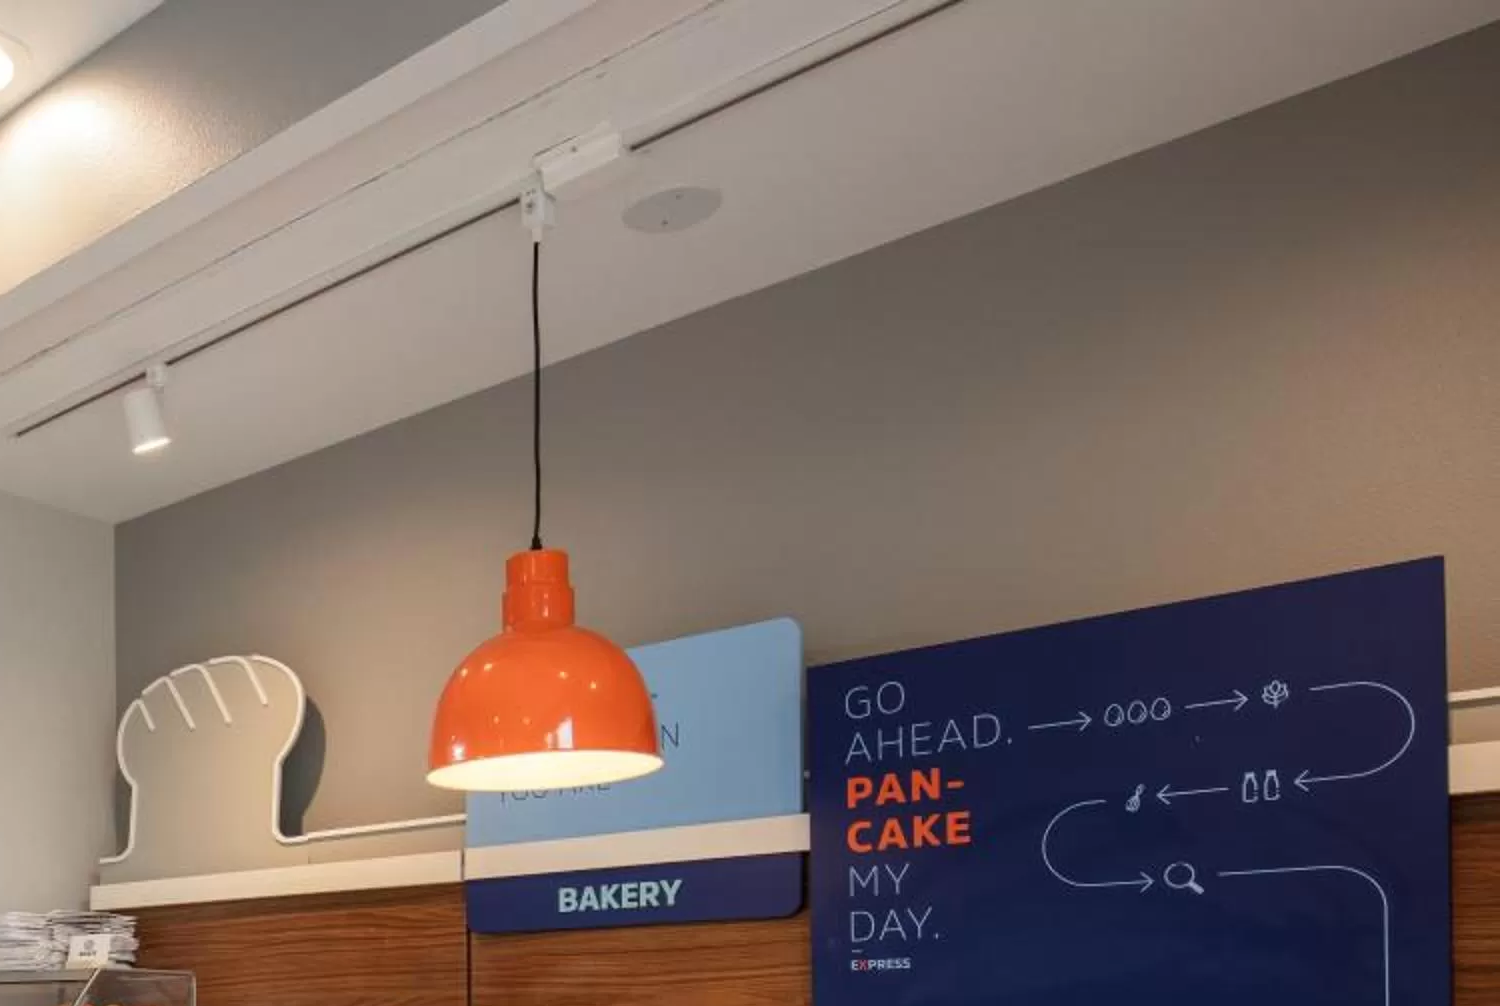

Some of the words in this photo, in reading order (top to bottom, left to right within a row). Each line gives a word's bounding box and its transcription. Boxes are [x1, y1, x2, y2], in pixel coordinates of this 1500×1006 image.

[844, 680, 906, 720] GO
[844, 712, 1013, 766] AHEAD.
[846, 766, 965, 810] PAN-
[846, 810, 972, 854] CAKE
[556, 878, 683, 914] BAKERY
[849, 863, 910, 897] MY
[850, 906, 940, 943] DAY.
[850, 957, 912, 971] EXPRESS
